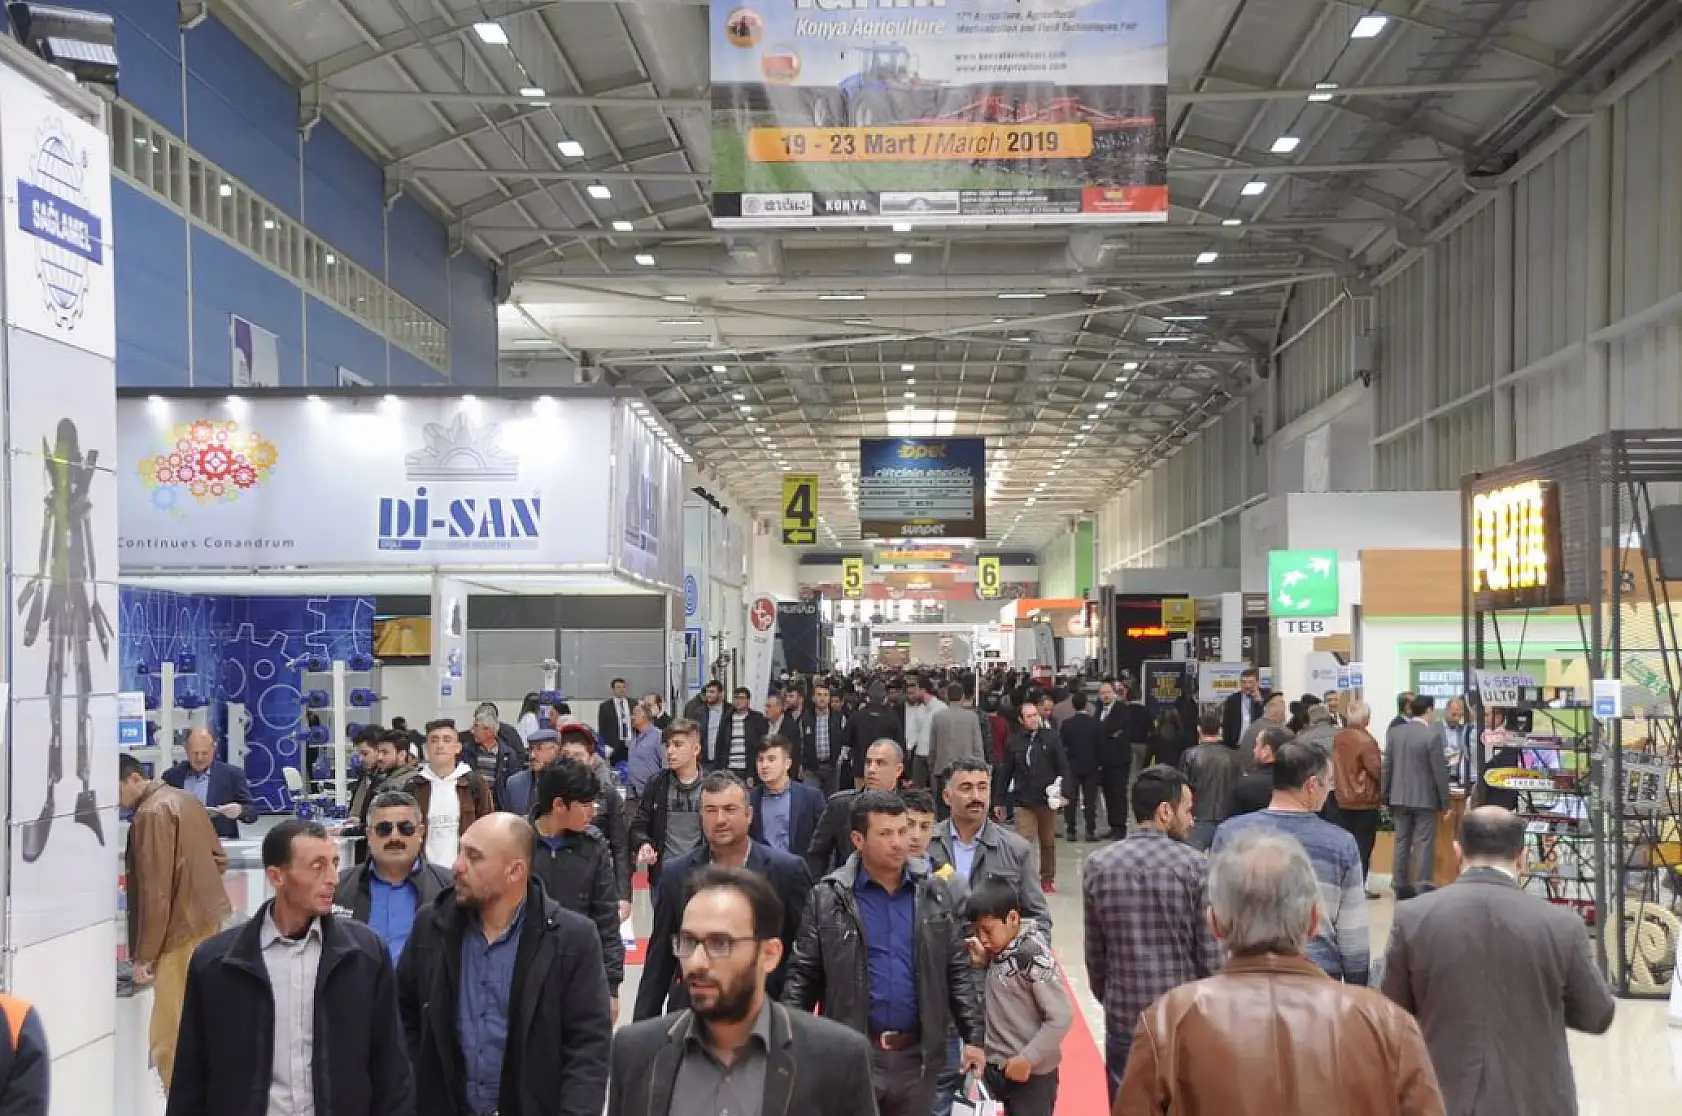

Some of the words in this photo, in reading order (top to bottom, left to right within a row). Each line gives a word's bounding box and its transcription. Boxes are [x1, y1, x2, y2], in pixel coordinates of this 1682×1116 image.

[782, 134, 806, 155] 19
[830, 134, 855, 154] 23
[864, 132, 917, 154] Mart
[935, 131, 1000, 154] March
[1006, 131, 1060, 152] 2019
[786, 485, 814, 528] 4
[204, 536, 295, 549] Conandrum
[845, 565, 860, 588] 5
[981, 564, 997, 588] 6
[1284, 619, 1325, 634] TEB
